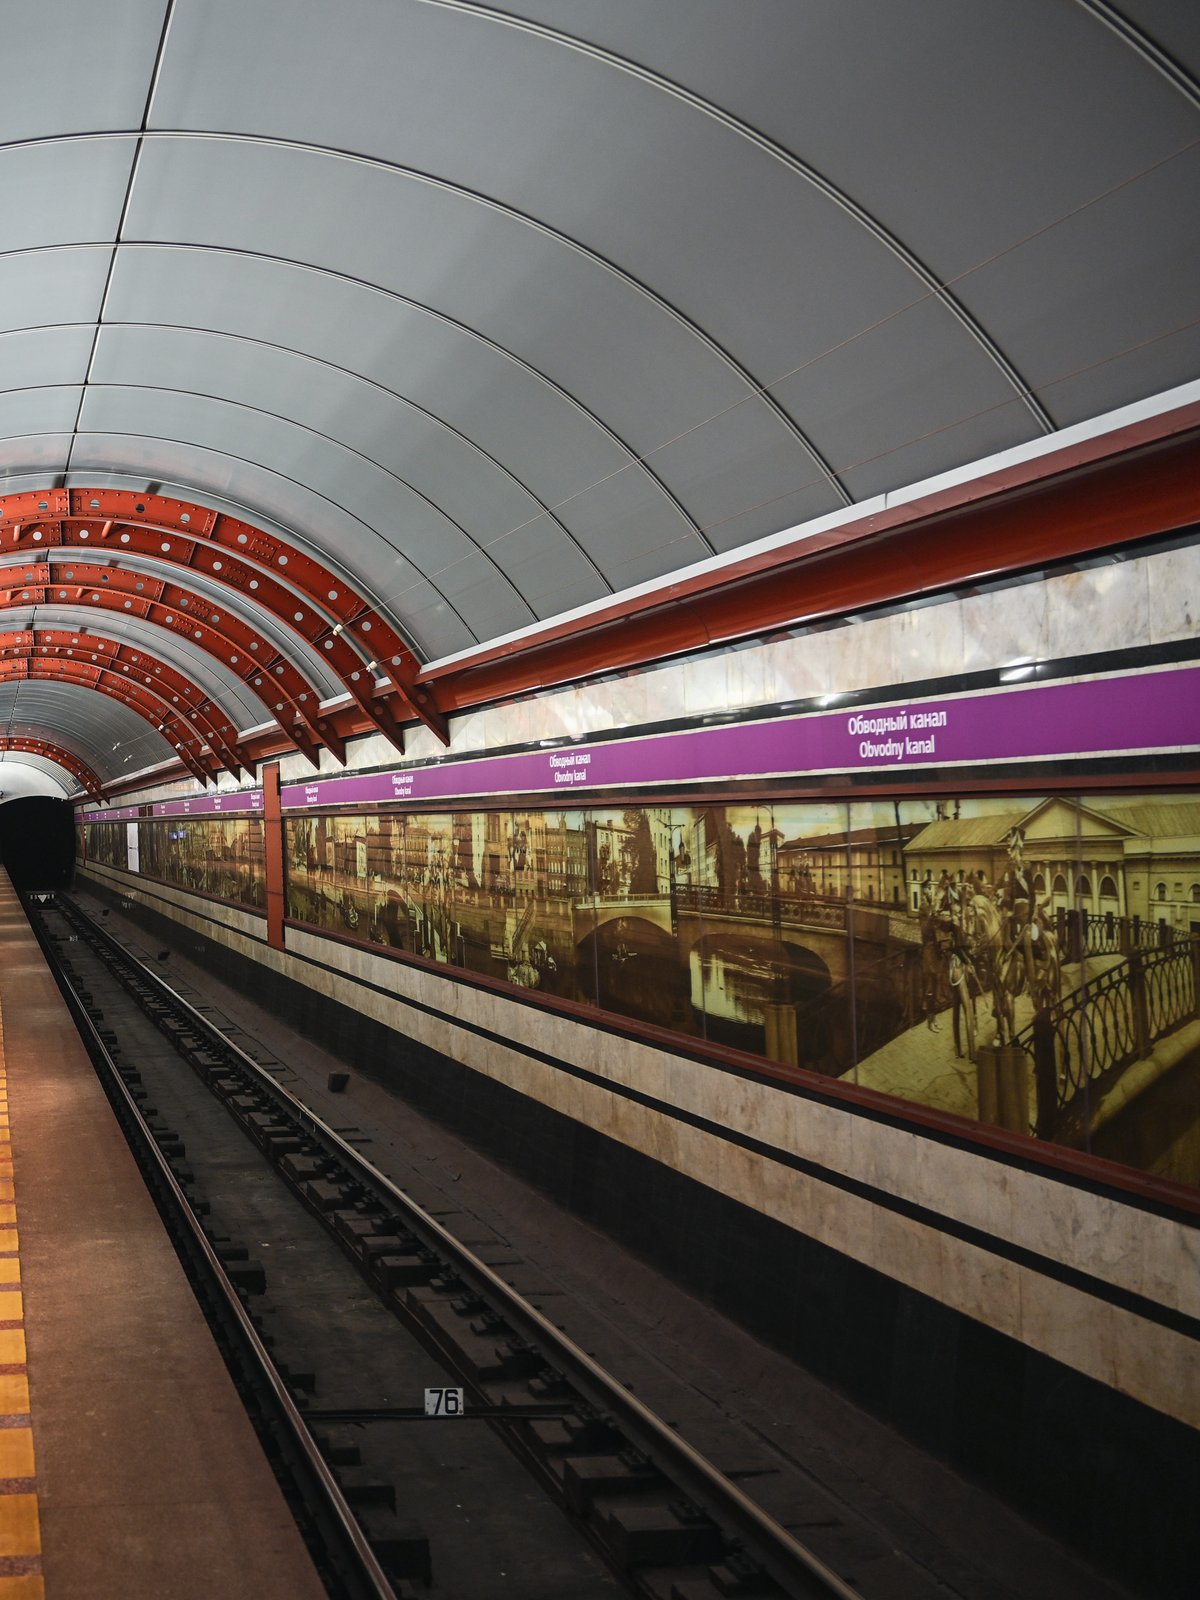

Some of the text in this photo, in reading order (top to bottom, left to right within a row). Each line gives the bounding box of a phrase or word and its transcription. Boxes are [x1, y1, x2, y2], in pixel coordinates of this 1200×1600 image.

[848, 710, 947, 736] Обводный канал
[859, 734, 935, 760] Obvodny kanal
[429, 1389, 459, 1415] 76
